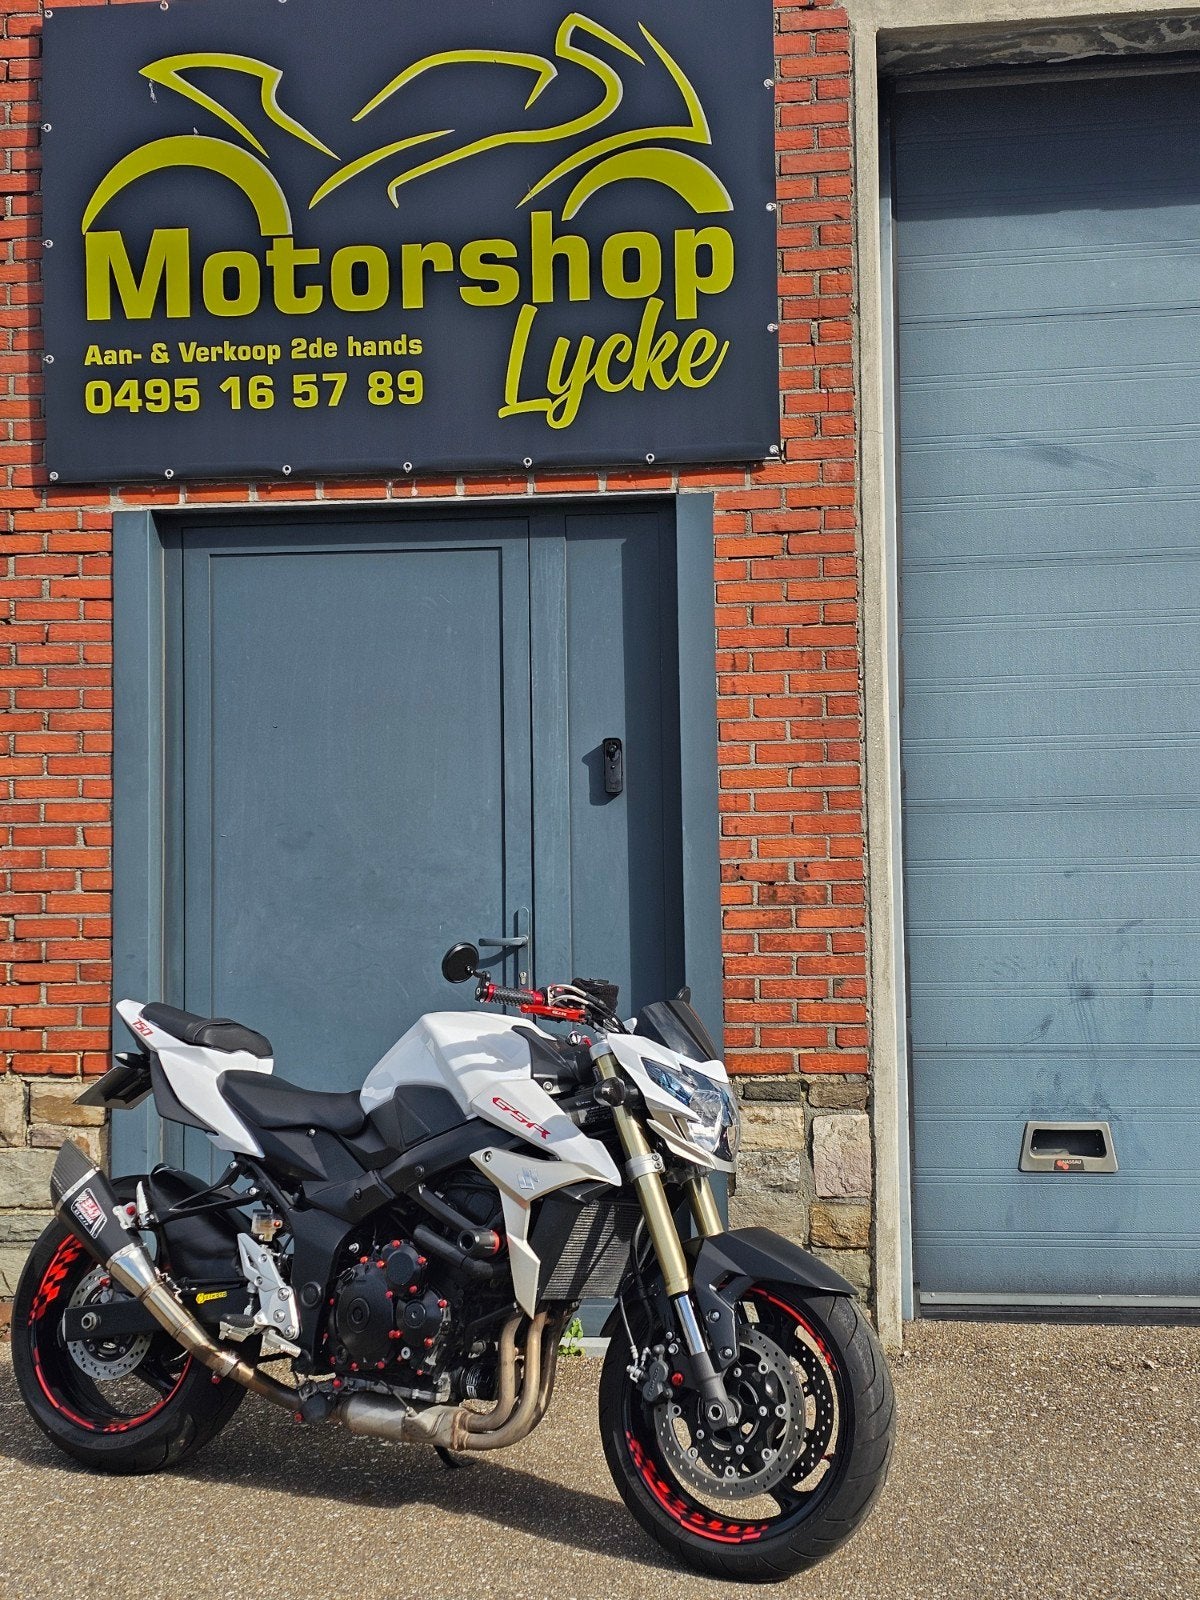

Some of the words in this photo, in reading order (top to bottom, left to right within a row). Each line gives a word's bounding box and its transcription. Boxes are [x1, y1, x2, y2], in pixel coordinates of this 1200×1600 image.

[85, 210, 735, 321] Motorshop
[85, 344, 143, 366] Aan-
[150, 343, 170, 364] &
[178, 341, 281, 364] Verkoop
[290, 337, 337, 360] 2de
[347, 335, 423, 357] hands
[497, 296, 730, 430] Lycke
[84, 377, 201, 414] 0495
[220, 374, 275, 410] 16
[292, 372, 348, 409] 57
[367, 369, 424, 406] 89
[492, 1097, 551, 1139] GSR
